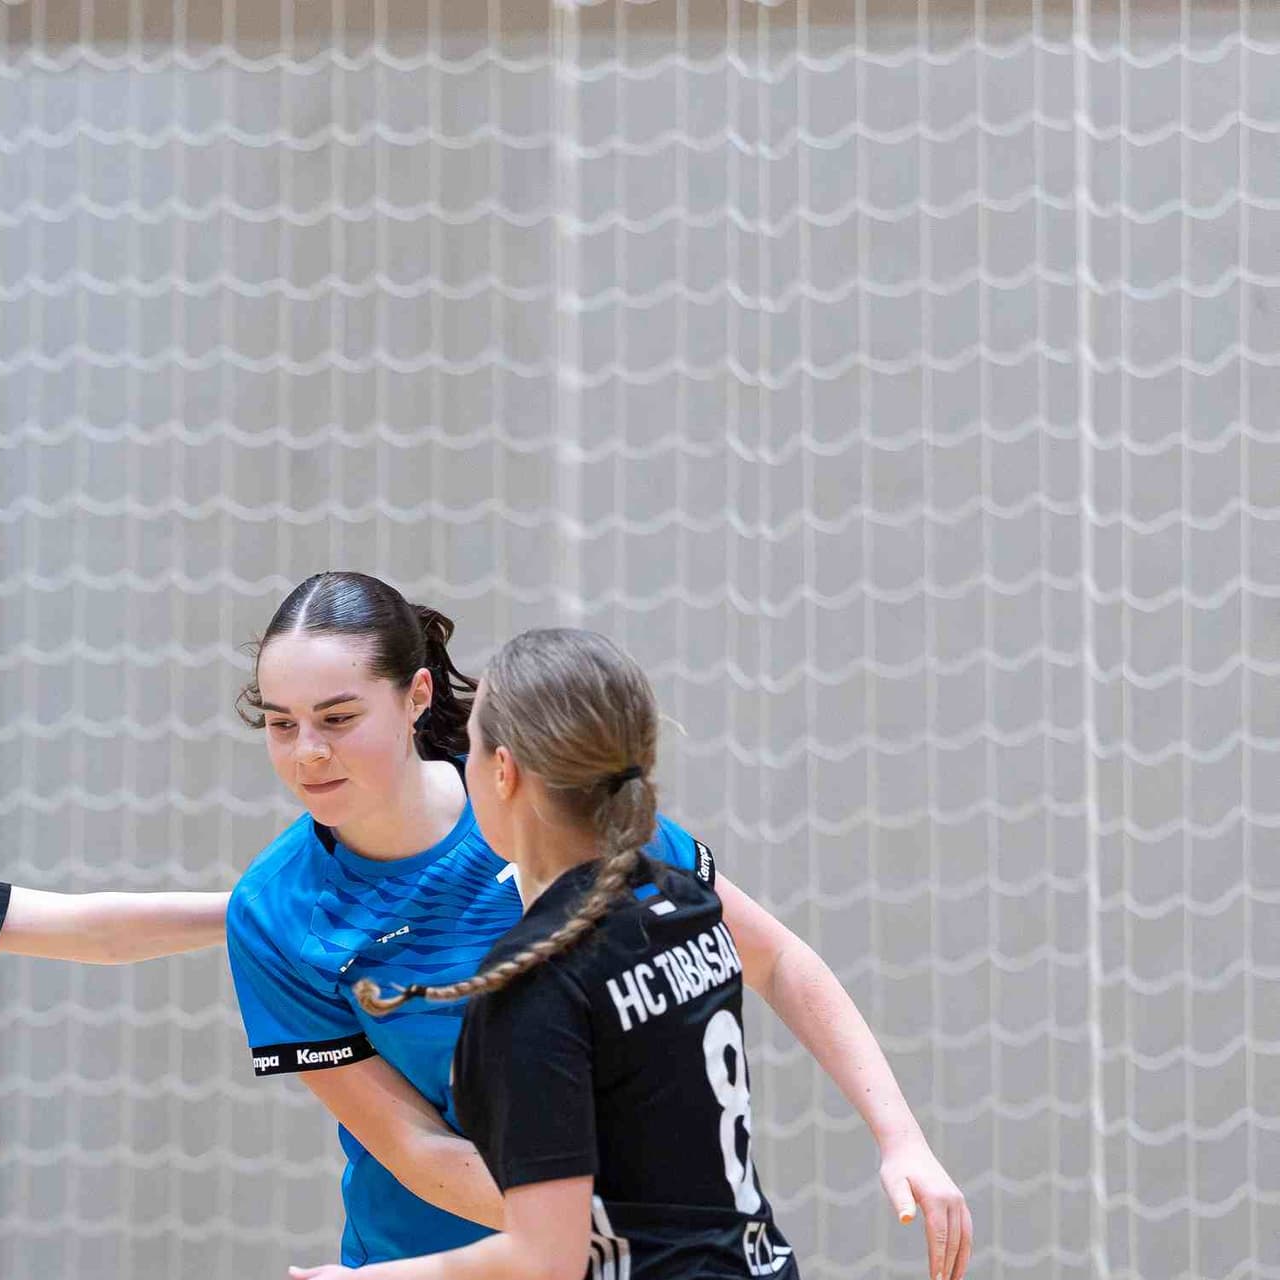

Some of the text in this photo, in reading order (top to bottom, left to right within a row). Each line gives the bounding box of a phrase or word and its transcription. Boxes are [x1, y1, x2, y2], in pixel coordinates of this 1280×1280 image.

[606, 962, 667, 1032] HC
[253, 1046, 353, 1071] mpa Kempa
[703, 1009, 762, 1216] 8
